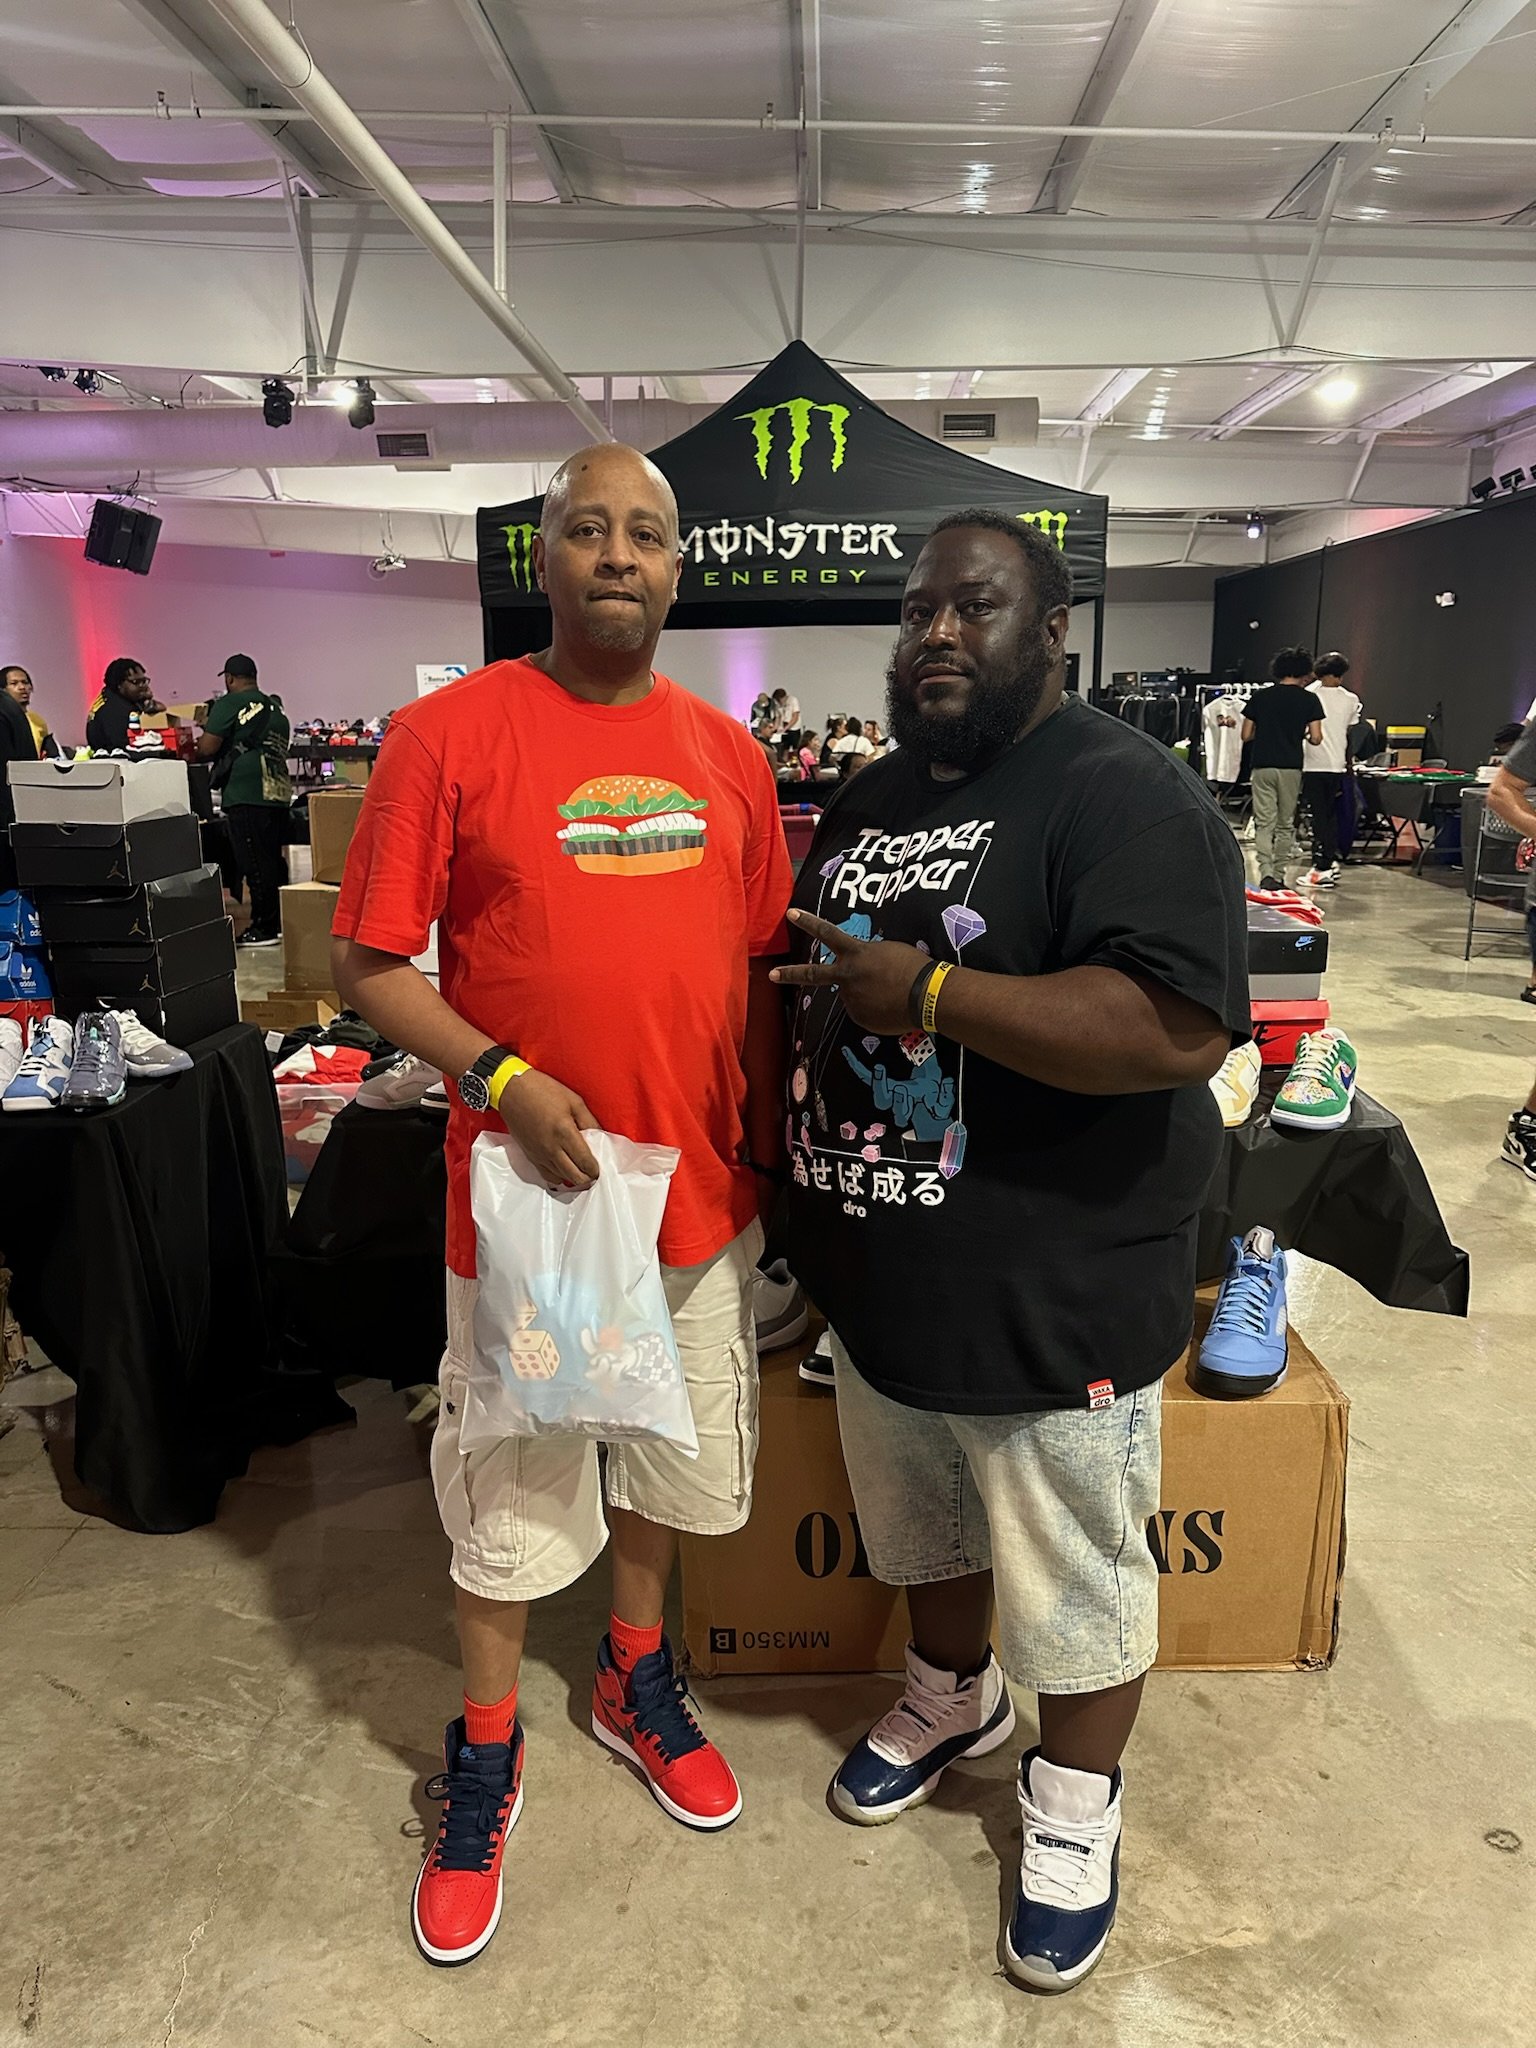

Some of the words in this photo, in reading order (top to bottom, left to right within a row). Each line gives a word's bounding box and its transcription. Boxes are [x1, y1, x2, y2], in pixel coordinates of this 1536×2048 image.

[678, 516, 904, 564] MONSTER
[704, 569, 866, 586] ENERGY
[849, 820, 996, 867] Trapper
[831, 858, 969, 908] Rapper
[842, 1200, 867, 1218] dro
[1092, 1386, 1110, 1396] WAKA
[1094, 1397, 1111, 1407] dro
[714, 1631, 730, 1649] B
[742, 1631, 830, 1649] MM350
